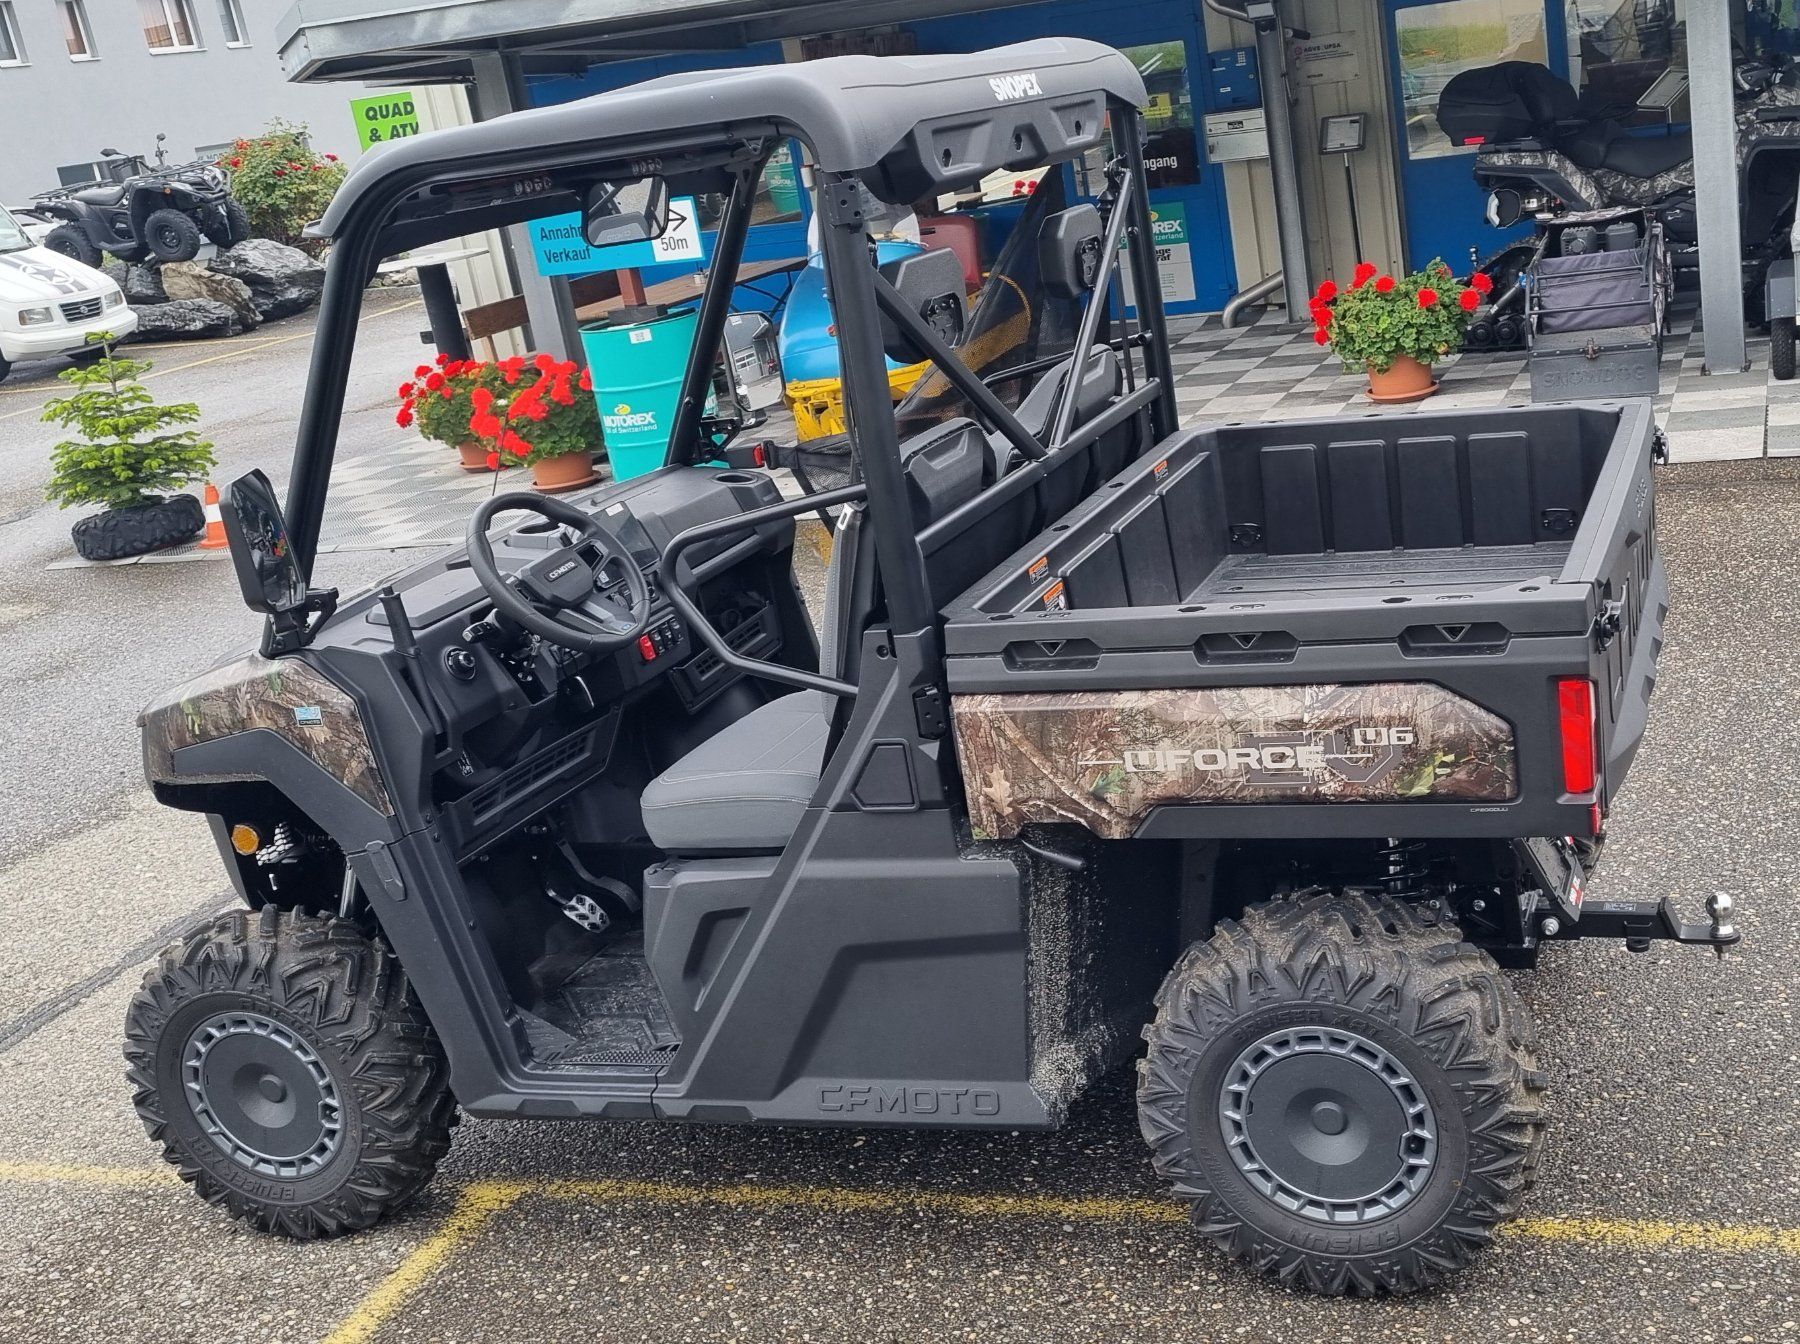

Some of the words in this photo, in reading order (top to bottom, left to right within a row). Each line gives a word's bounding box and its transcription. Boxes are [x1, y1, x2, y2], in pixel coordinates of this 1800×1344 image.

[989, 73, 1042, 101] SNOPEX
[365, 101, 415, 121] QUAD
[369, 128, 382, 143] &
[390, 122, 419, 139] ATV
[1143, 156, 1178, 170] ngang
[661, 236, 689, 251] 50m
[1155, 232, 1184, 242] tzerland
[544, 246, 592, 263] Verkauf
[603, 412, 656, 427] MOTOREX
[618, 423, 657, 433] Switzerland
[549, 561, 576, 578] CFMOTO
[818, 1084, 1000, 1116] CFMOTO
